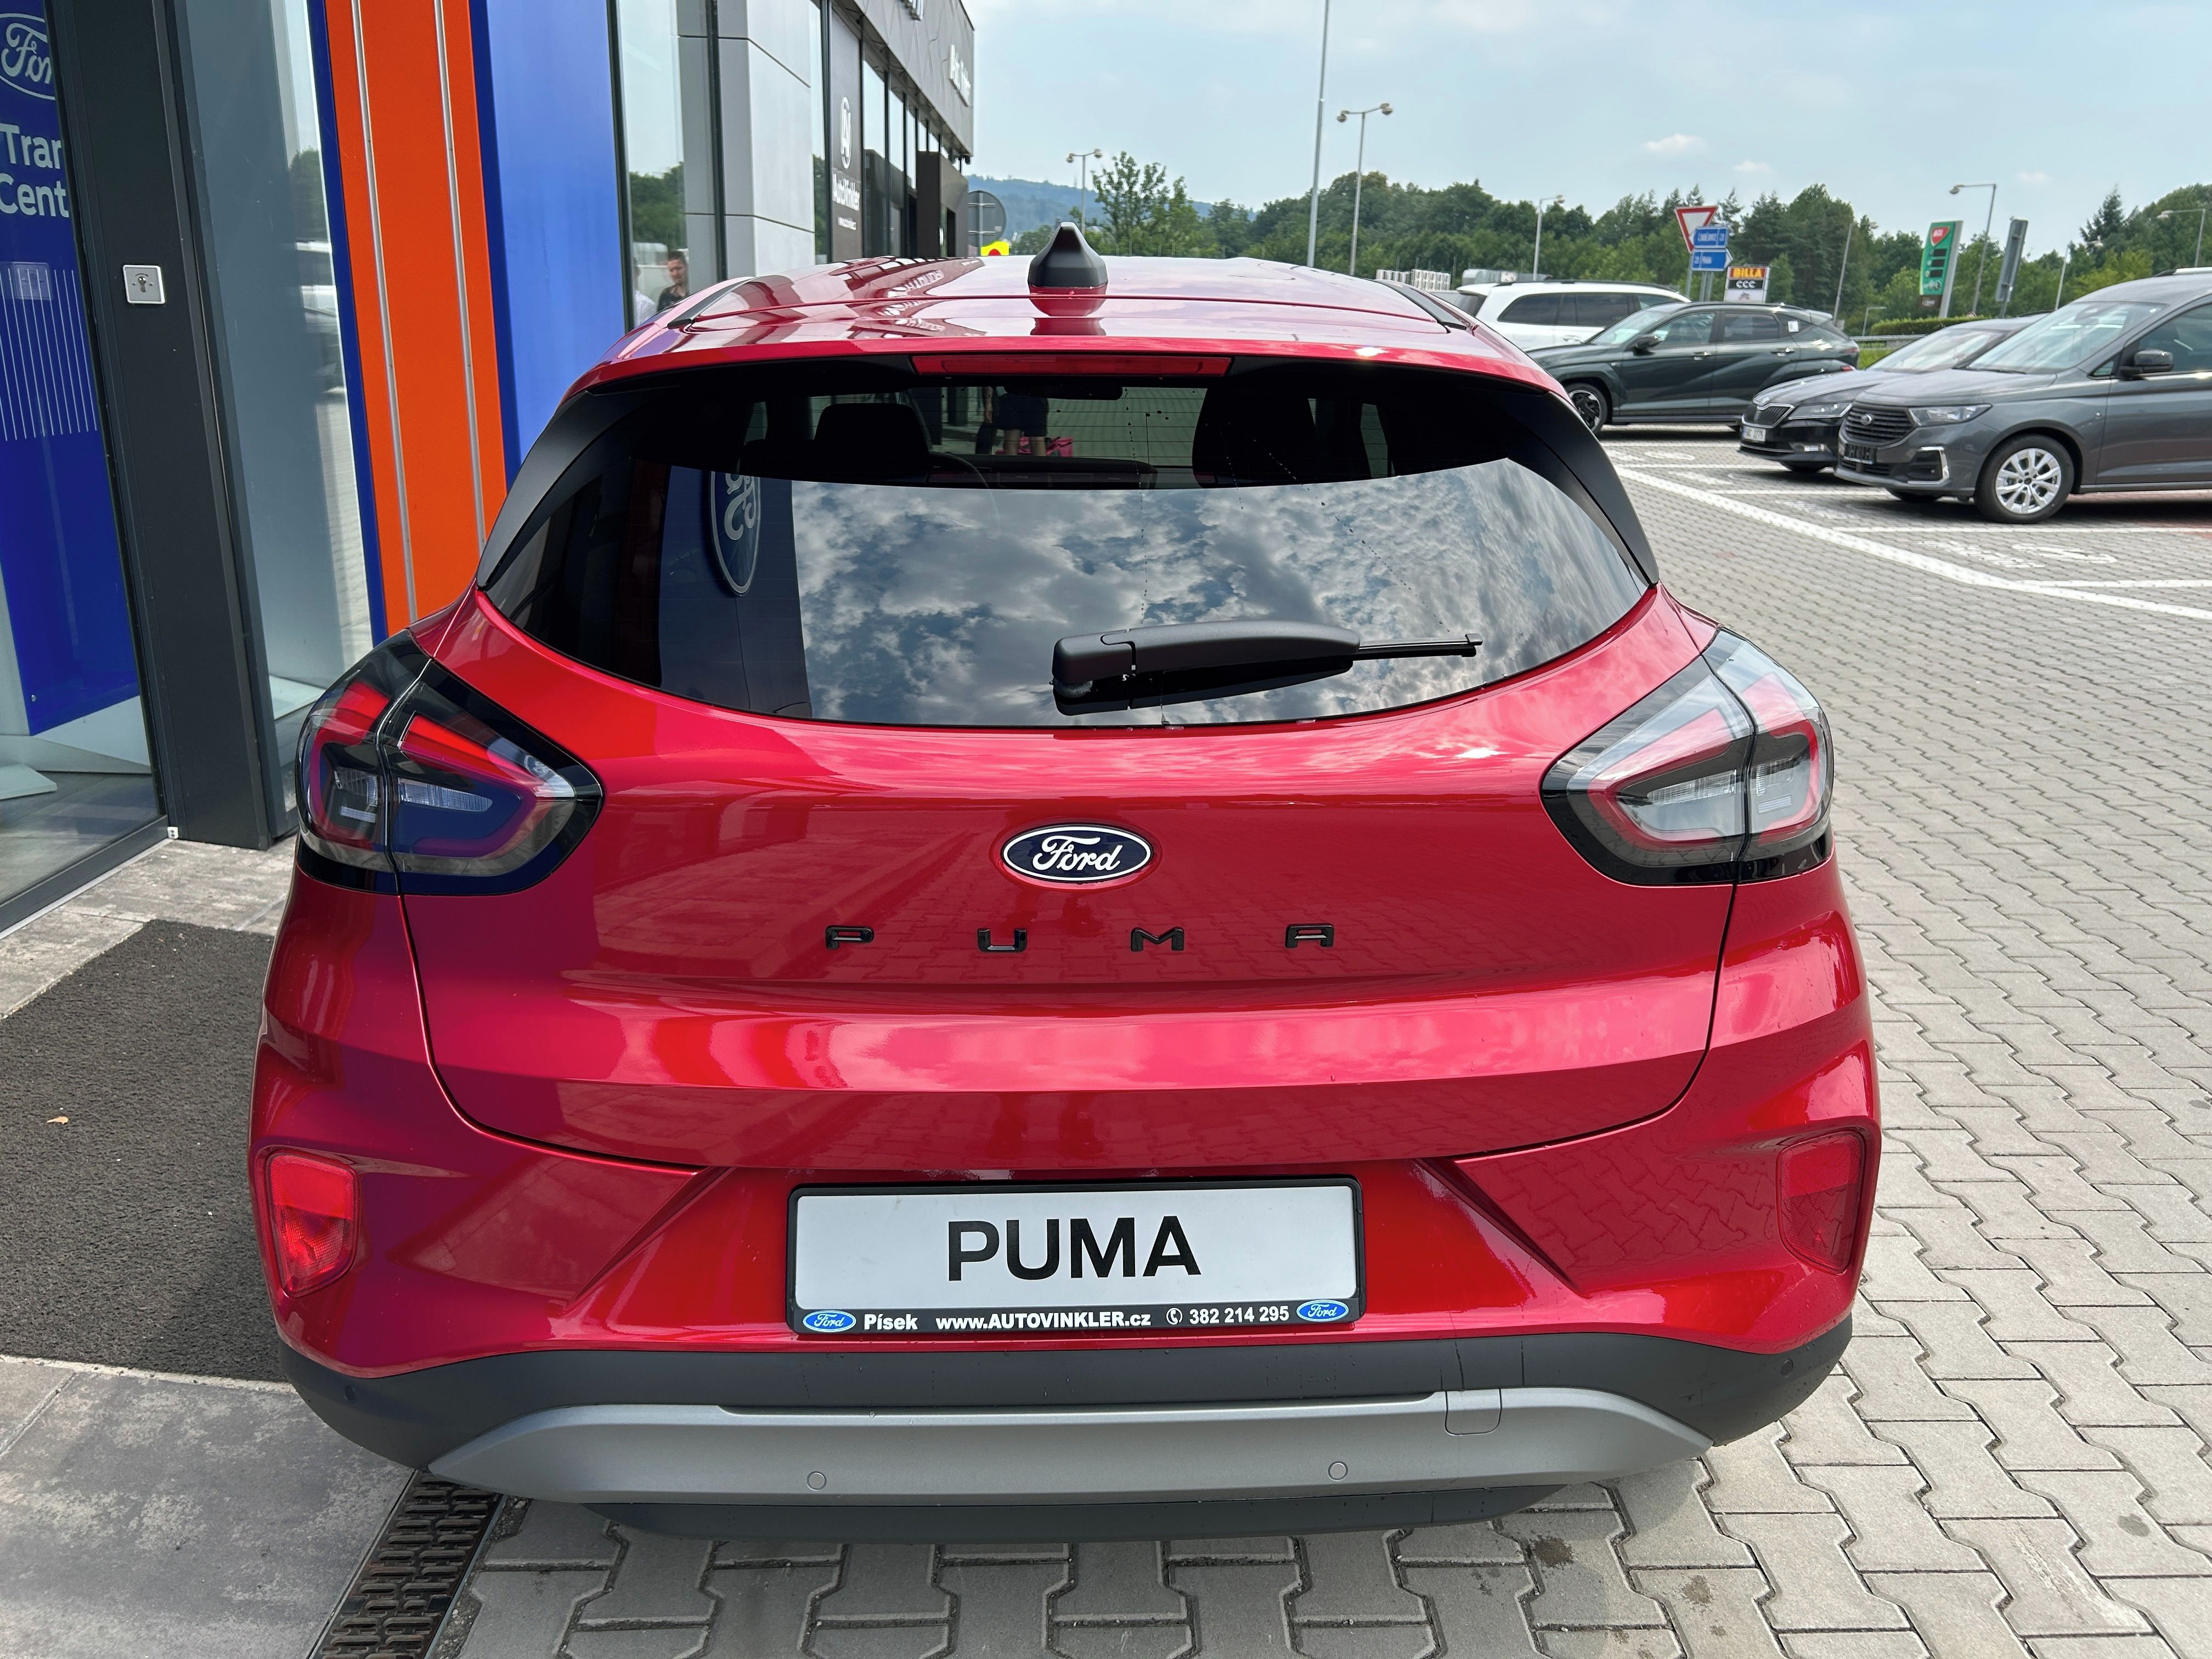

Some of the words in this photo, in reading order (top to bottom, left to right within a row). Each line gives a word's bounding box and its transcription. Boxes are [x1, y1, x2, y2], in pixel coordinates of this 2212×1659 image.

[1, 22, 53, 85] For
[1733, 268, 1762, 278] BILLA
[1736, 280, 1756, 289] CCC
[1032, 835, 1123, 871] Ford
[823, 923, 1335, 953] PUMA
[948, 1215, 1201, 1282] PUMA
[814, 1313, 844, 1327] Ford
[864, 1313, 918, 1330] Písek
[935, 1311, 1151, 1330] www.AUTOVINKLER.cz
[1189, 1308, 1220, 1324] 382
[1224, 1307, 1255, 1323] 214
[1259, 1306, 1289, 1322] 295
[1307, 1303, 1337, 1317] Ford
